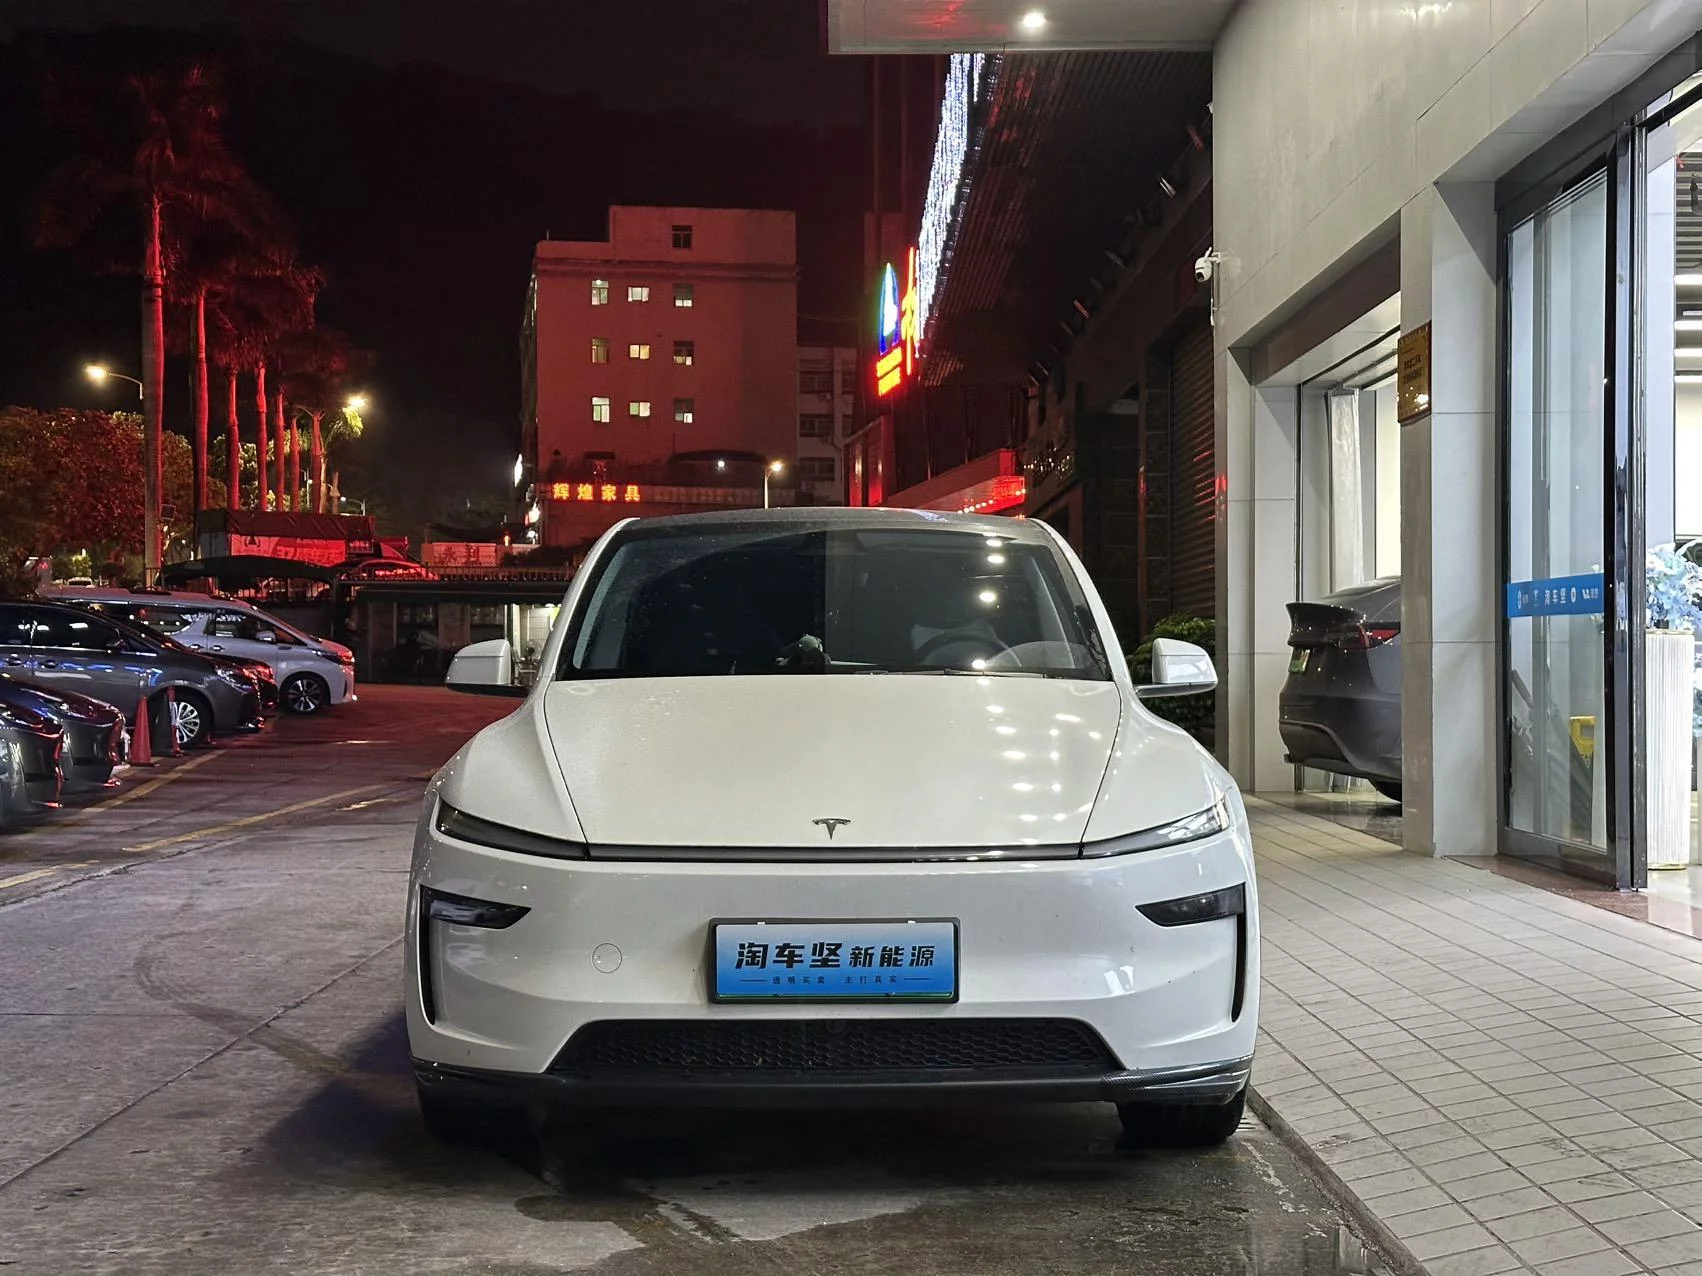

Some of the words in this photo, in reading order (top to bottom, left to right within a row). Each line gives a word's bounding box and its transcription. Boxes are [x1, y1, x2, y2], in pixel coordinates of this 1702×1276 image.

[552, 483, 641, 503] 辉煌家具
[772, 975, 826, 985] 透明买卖
[844, 975, 897, 985] 主打真实
